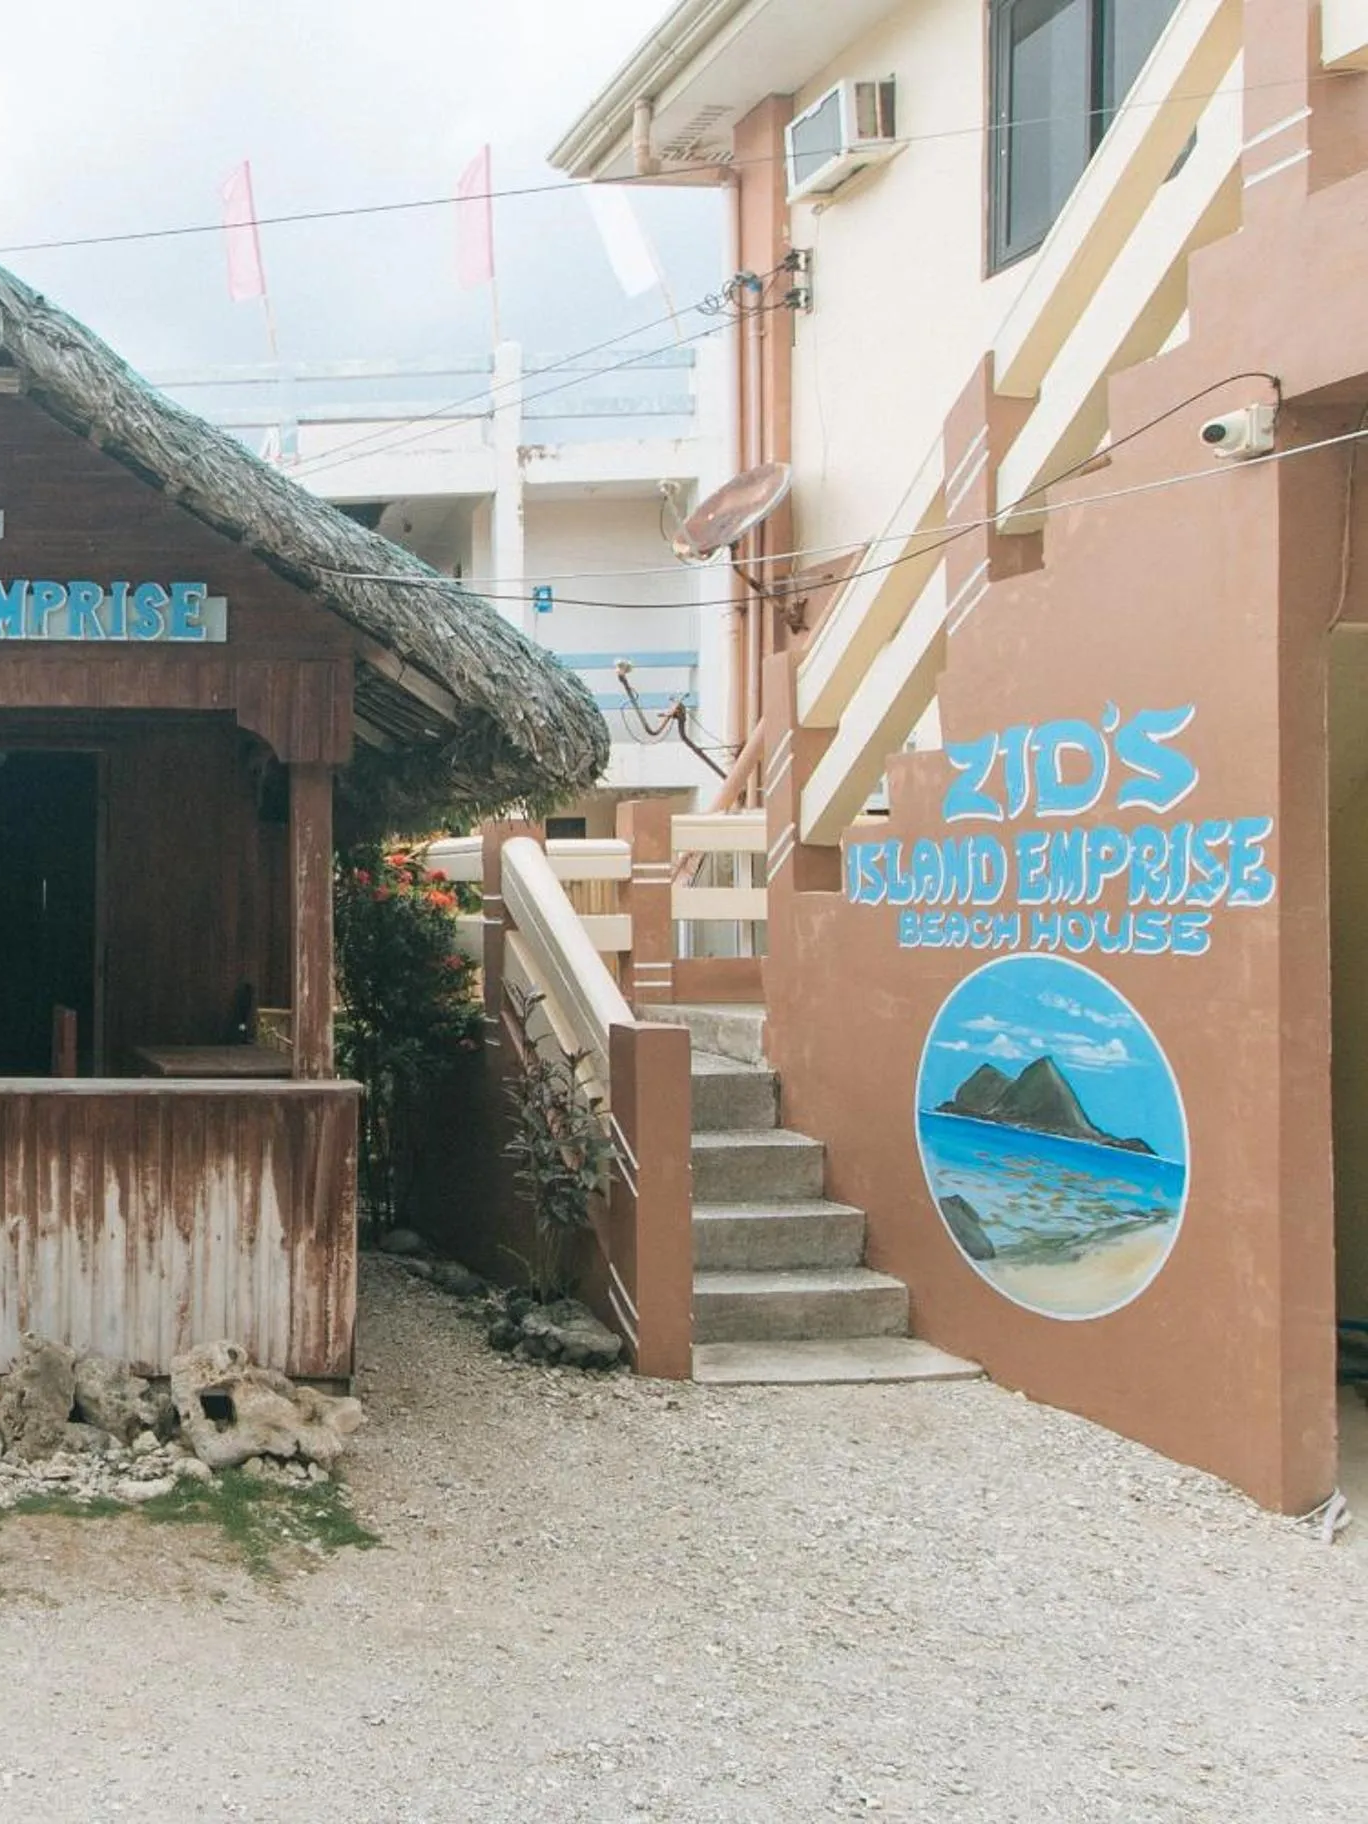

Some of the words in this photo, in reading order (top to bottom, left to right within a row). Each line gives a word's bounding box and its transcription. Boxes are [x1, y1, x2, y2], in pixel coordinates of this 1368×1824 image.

[942, 700, 1199, 823] ZID'S
[846, 834, 1008, 906] ISLAND
[1015, 816, 1277, 907] EMPRISE
[898, 909, 1020, 950] BEACH
[1031, 911, 1214, 956] HOUSE
